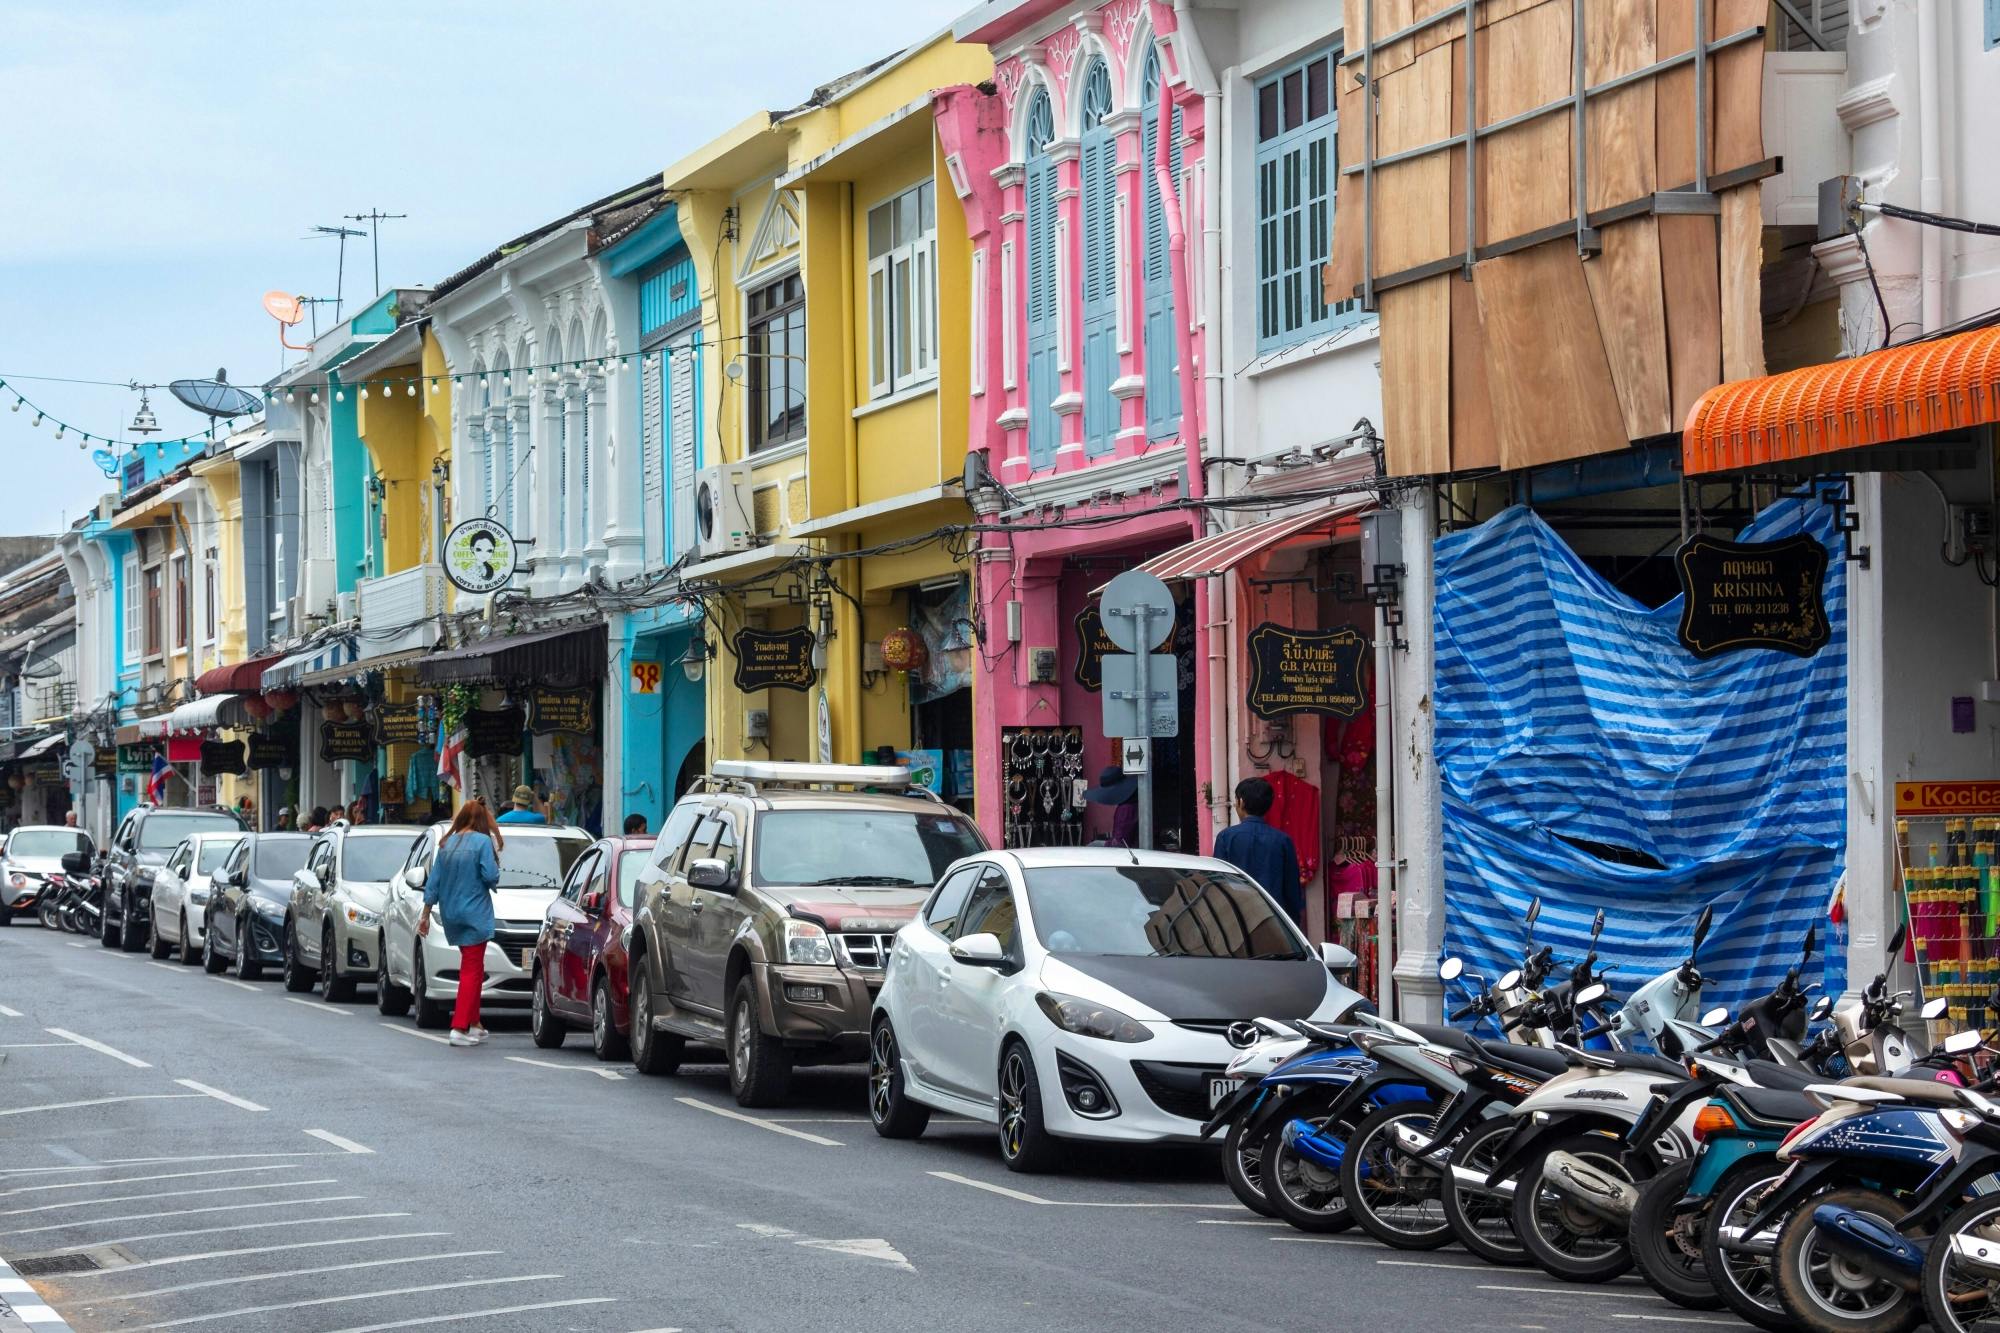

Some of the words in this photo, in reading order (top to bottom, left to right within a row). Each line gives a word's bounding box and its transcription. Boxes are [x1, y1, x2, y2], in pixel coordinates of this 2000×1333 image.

[1723, 560, 1773, 580] กฤษณา
[1713, 583, 1784, 598] KRISHNA
[1303, 662, 1337, 672] PATEH
